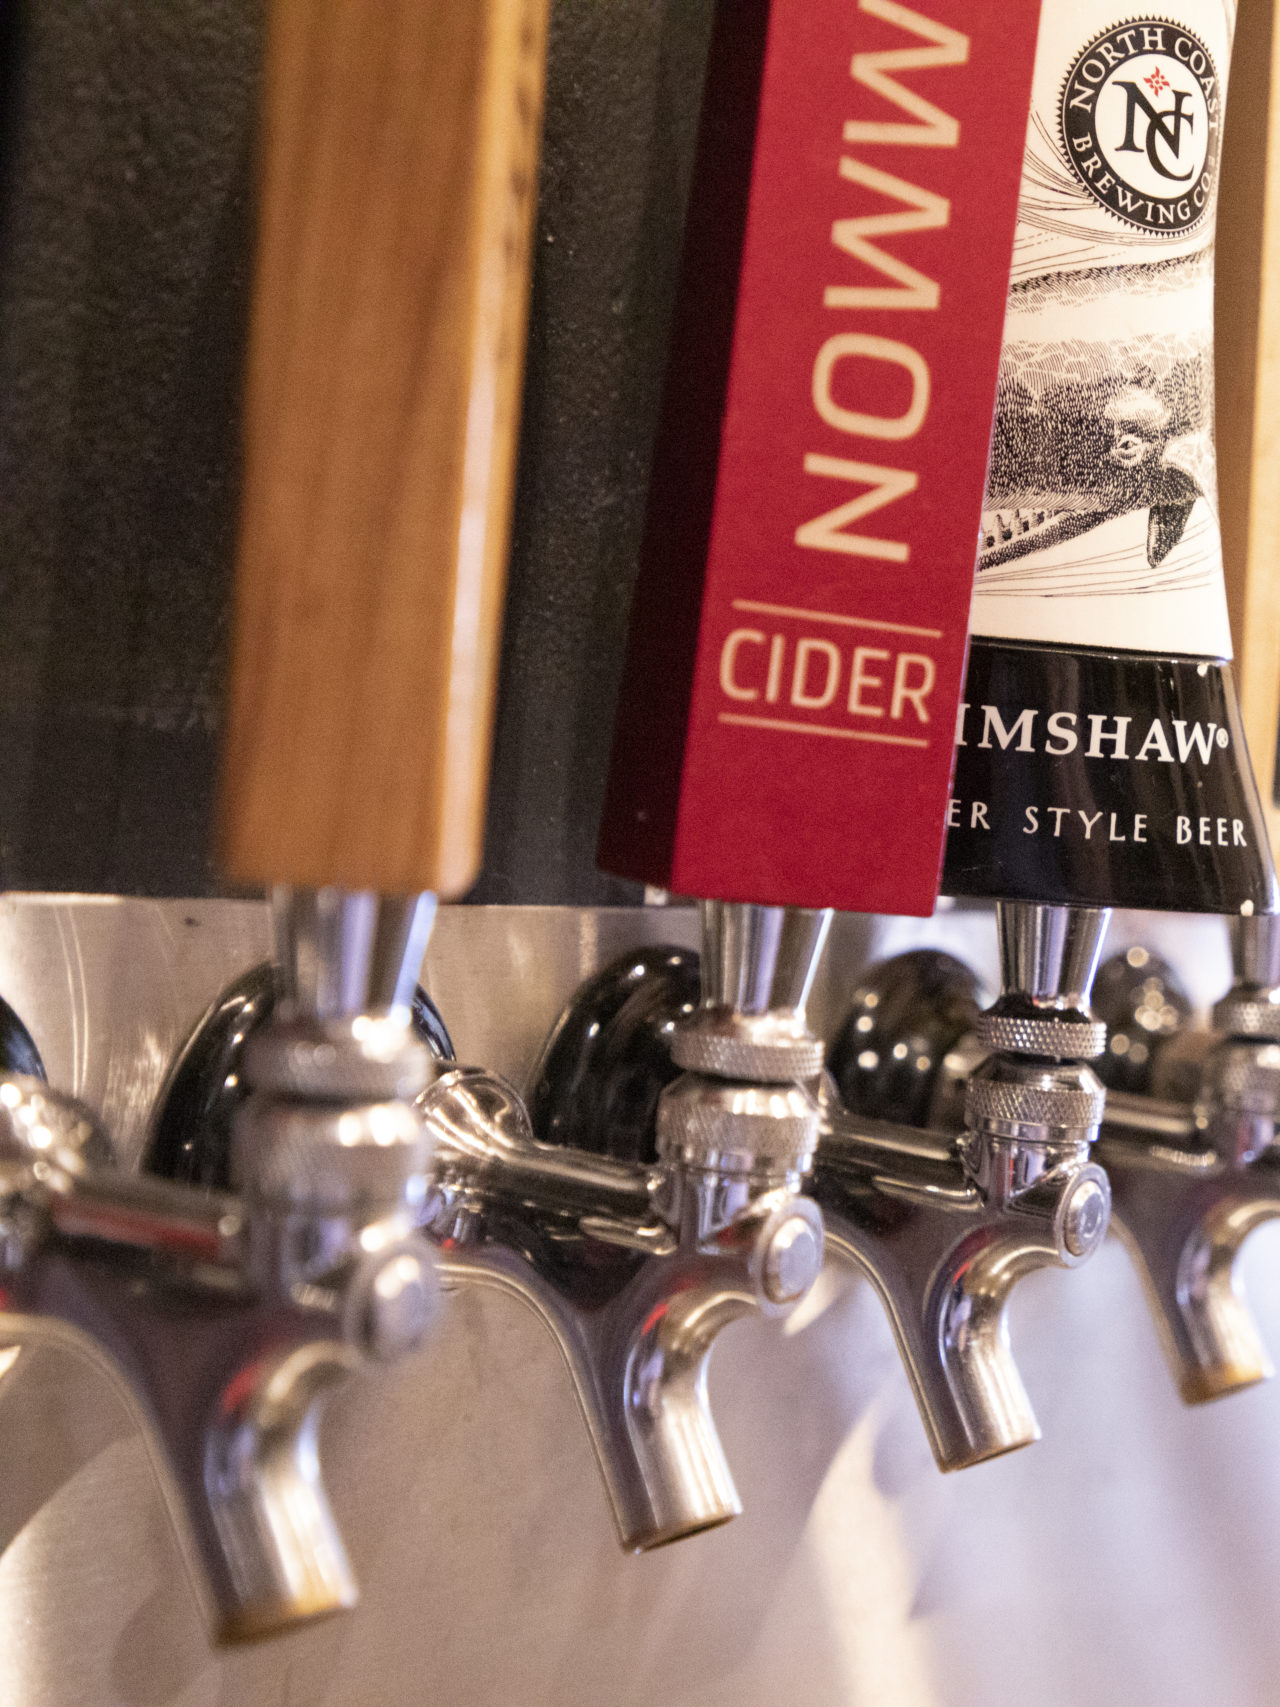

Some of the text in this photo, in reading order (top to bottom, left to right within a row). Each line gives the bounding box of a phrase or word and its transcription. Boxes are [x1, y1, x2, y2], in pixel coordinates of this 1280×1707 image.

[1069, 26, 1219, 131] NORTH COAST
[1072, 131, 1192, 224] BREWING
[719, 627, 936, 723] CIDER
[1022, 806, 1148, 844] STYLE
[1176, 815, 1248, 848] BEER
